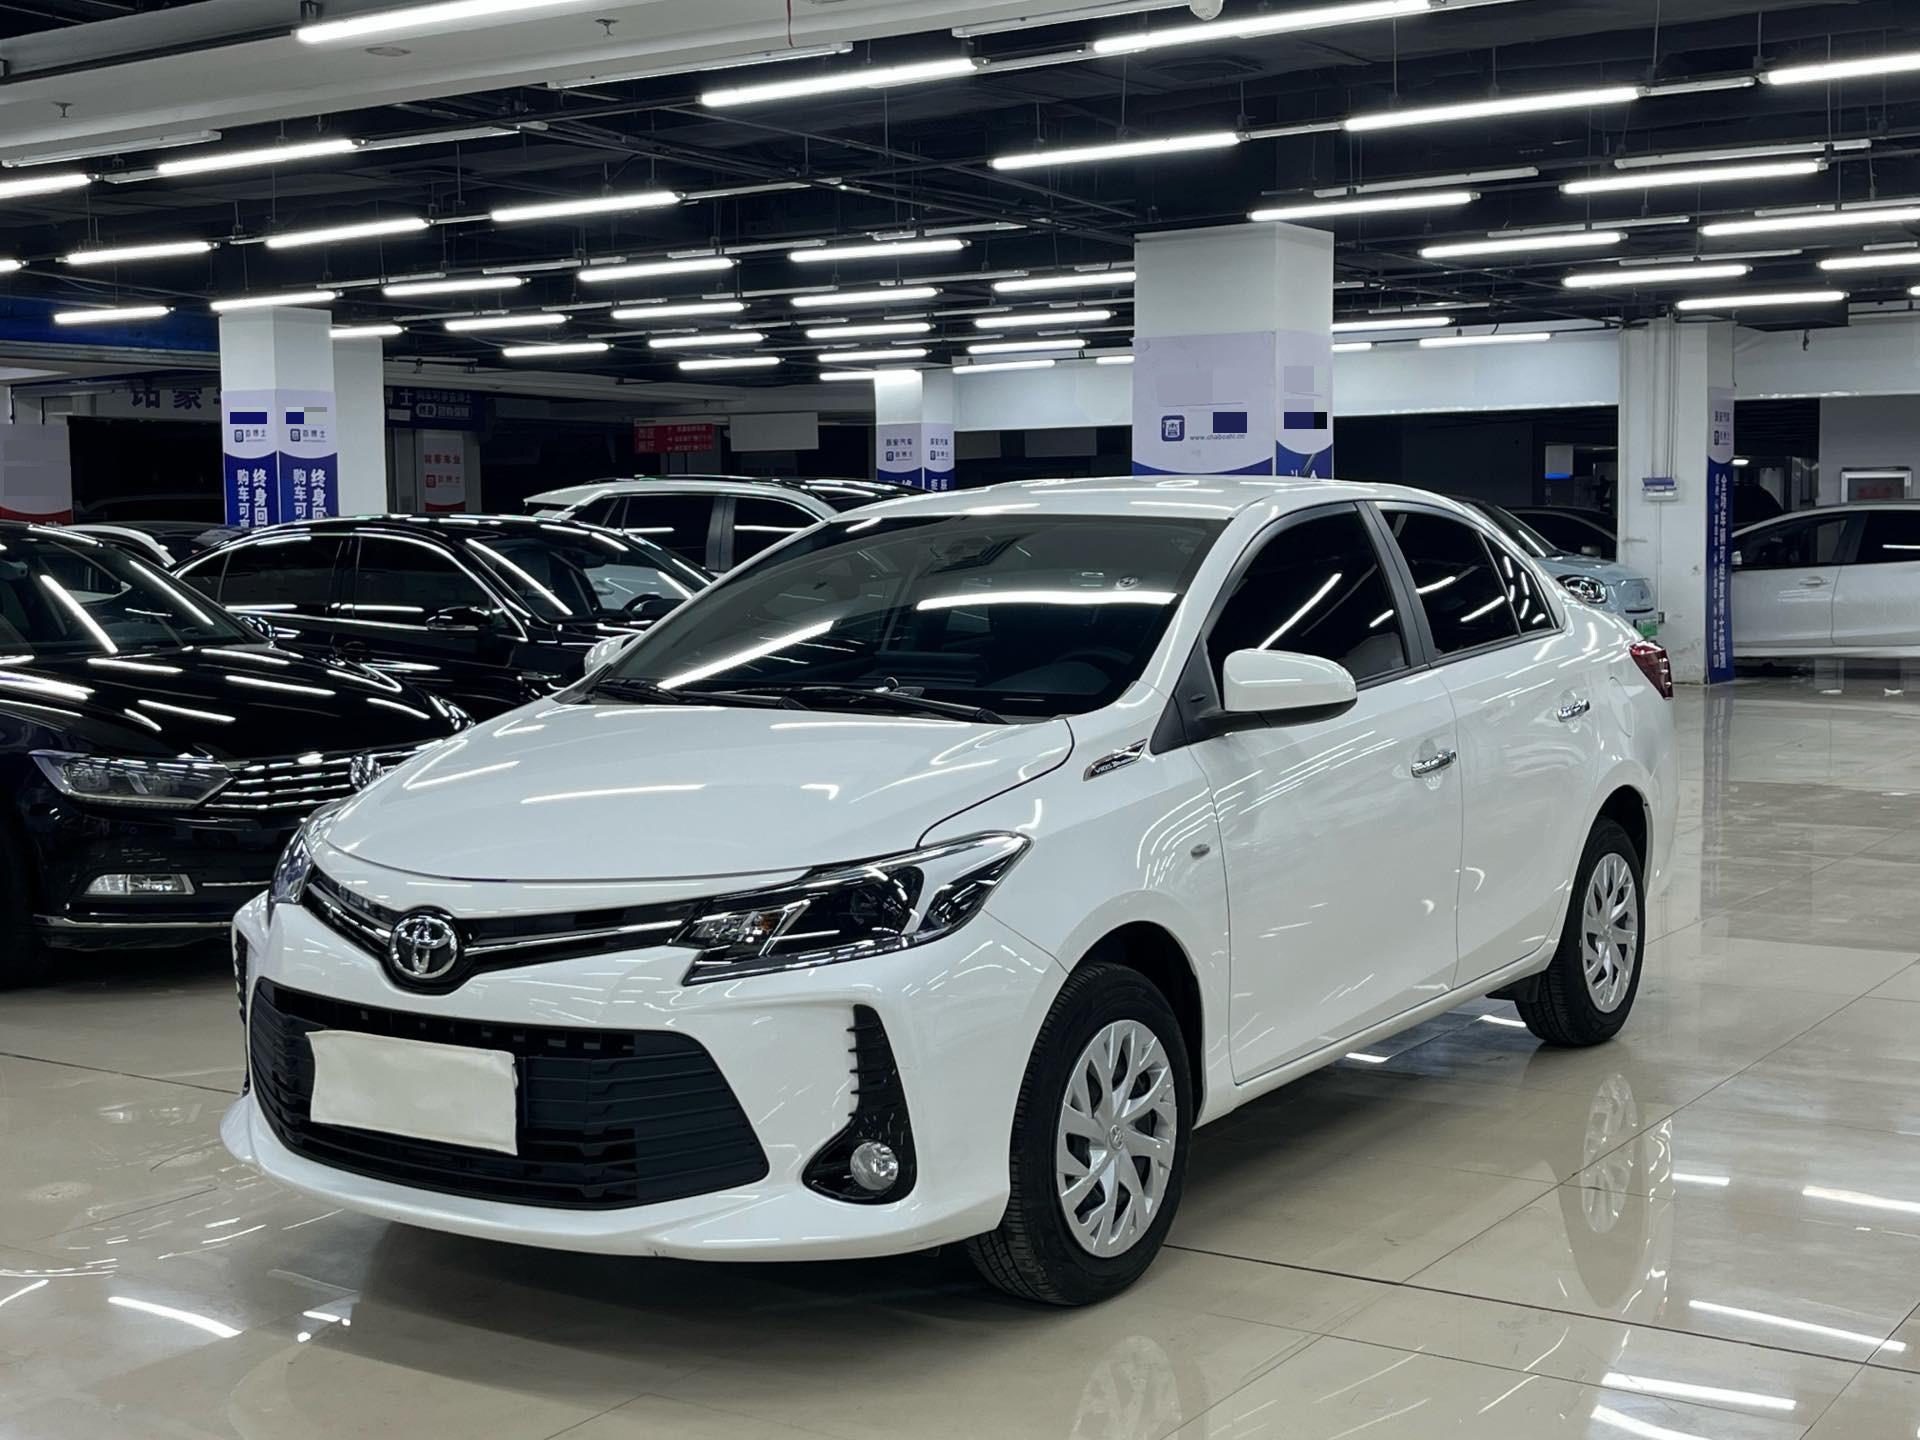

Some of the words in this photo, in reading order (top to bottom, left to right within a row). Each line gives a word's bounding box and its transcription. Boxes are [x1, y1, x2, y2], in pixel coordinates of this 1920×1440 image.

[253, 468, 268, 529] 终身回
[293, 468, 307, 522] 购车可
